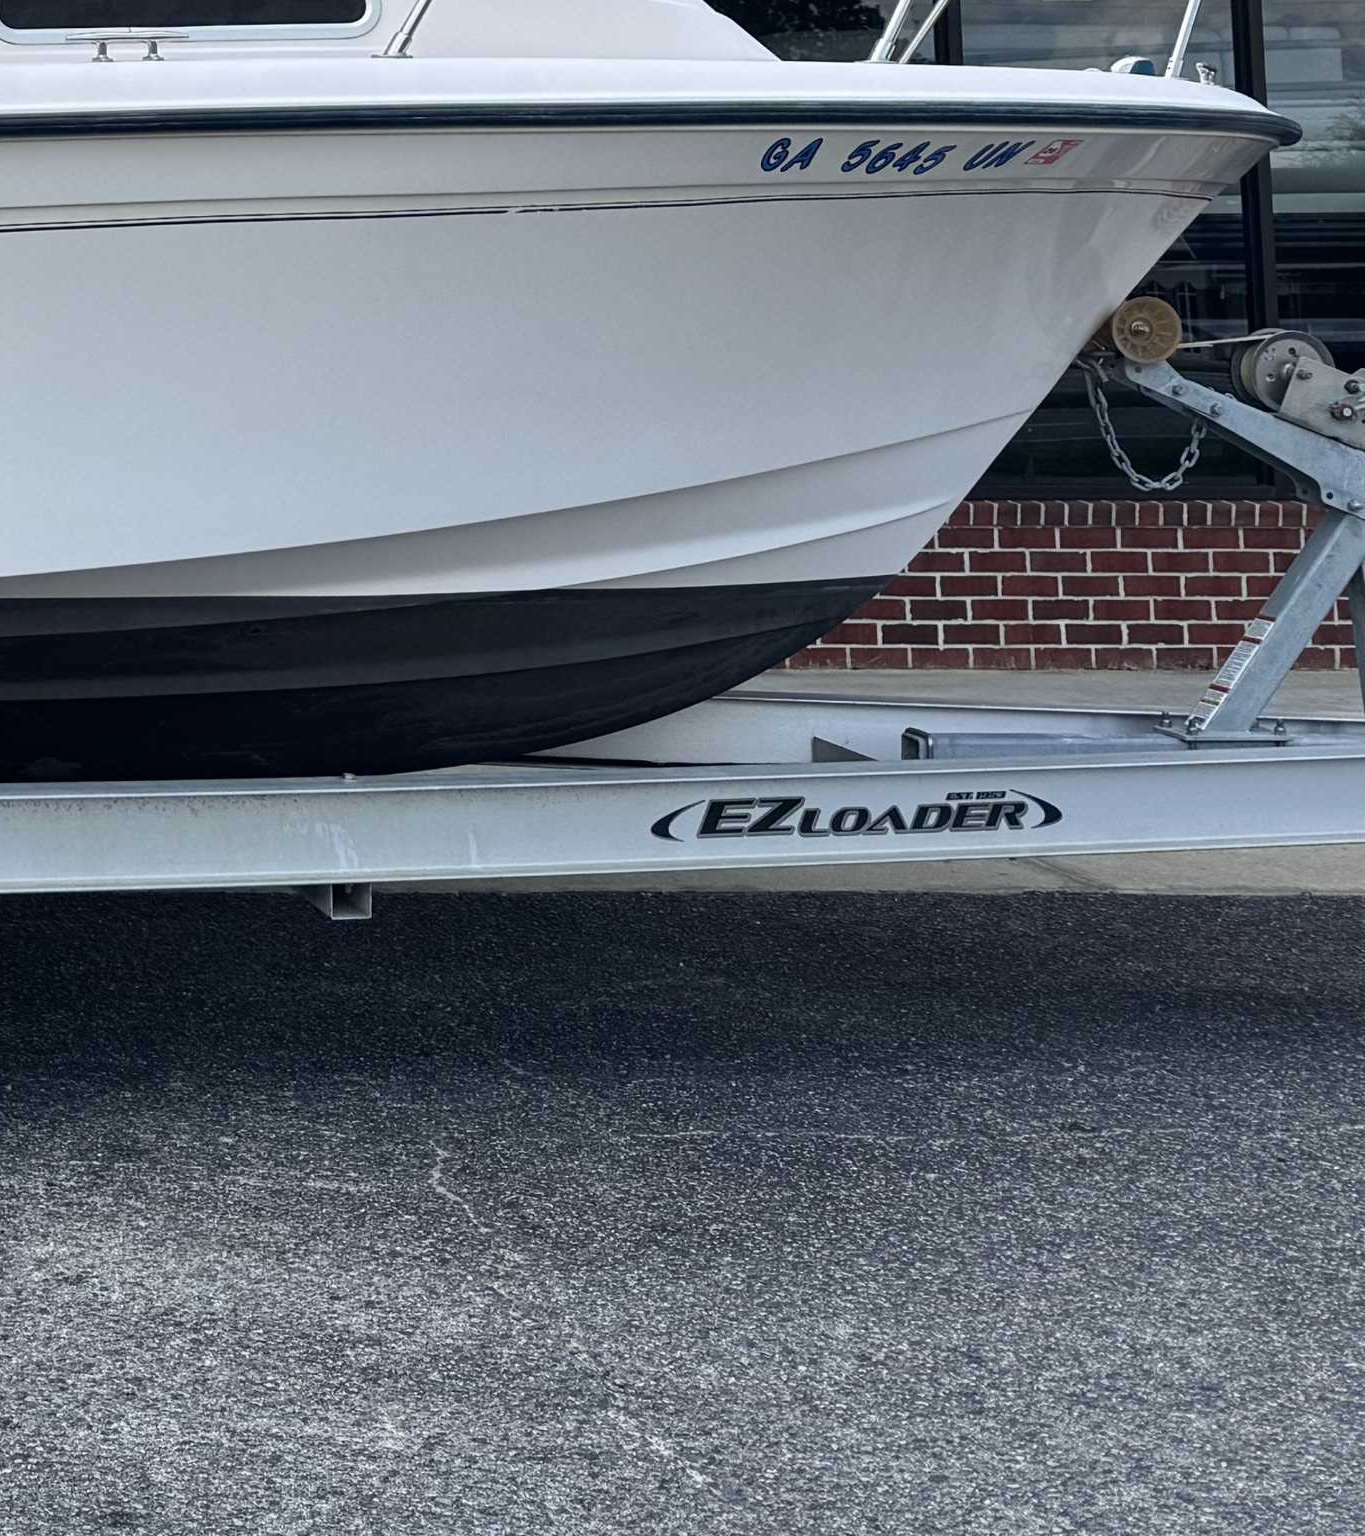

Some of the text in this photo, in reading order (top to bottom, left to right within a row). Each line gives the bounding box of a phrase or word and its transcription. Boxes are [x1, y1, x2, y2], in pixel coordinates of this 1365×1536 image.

[760, 137, 824, 173] GA
[841, 139, 957, 176] 5645
[963, 139, 1037, 172] UN
